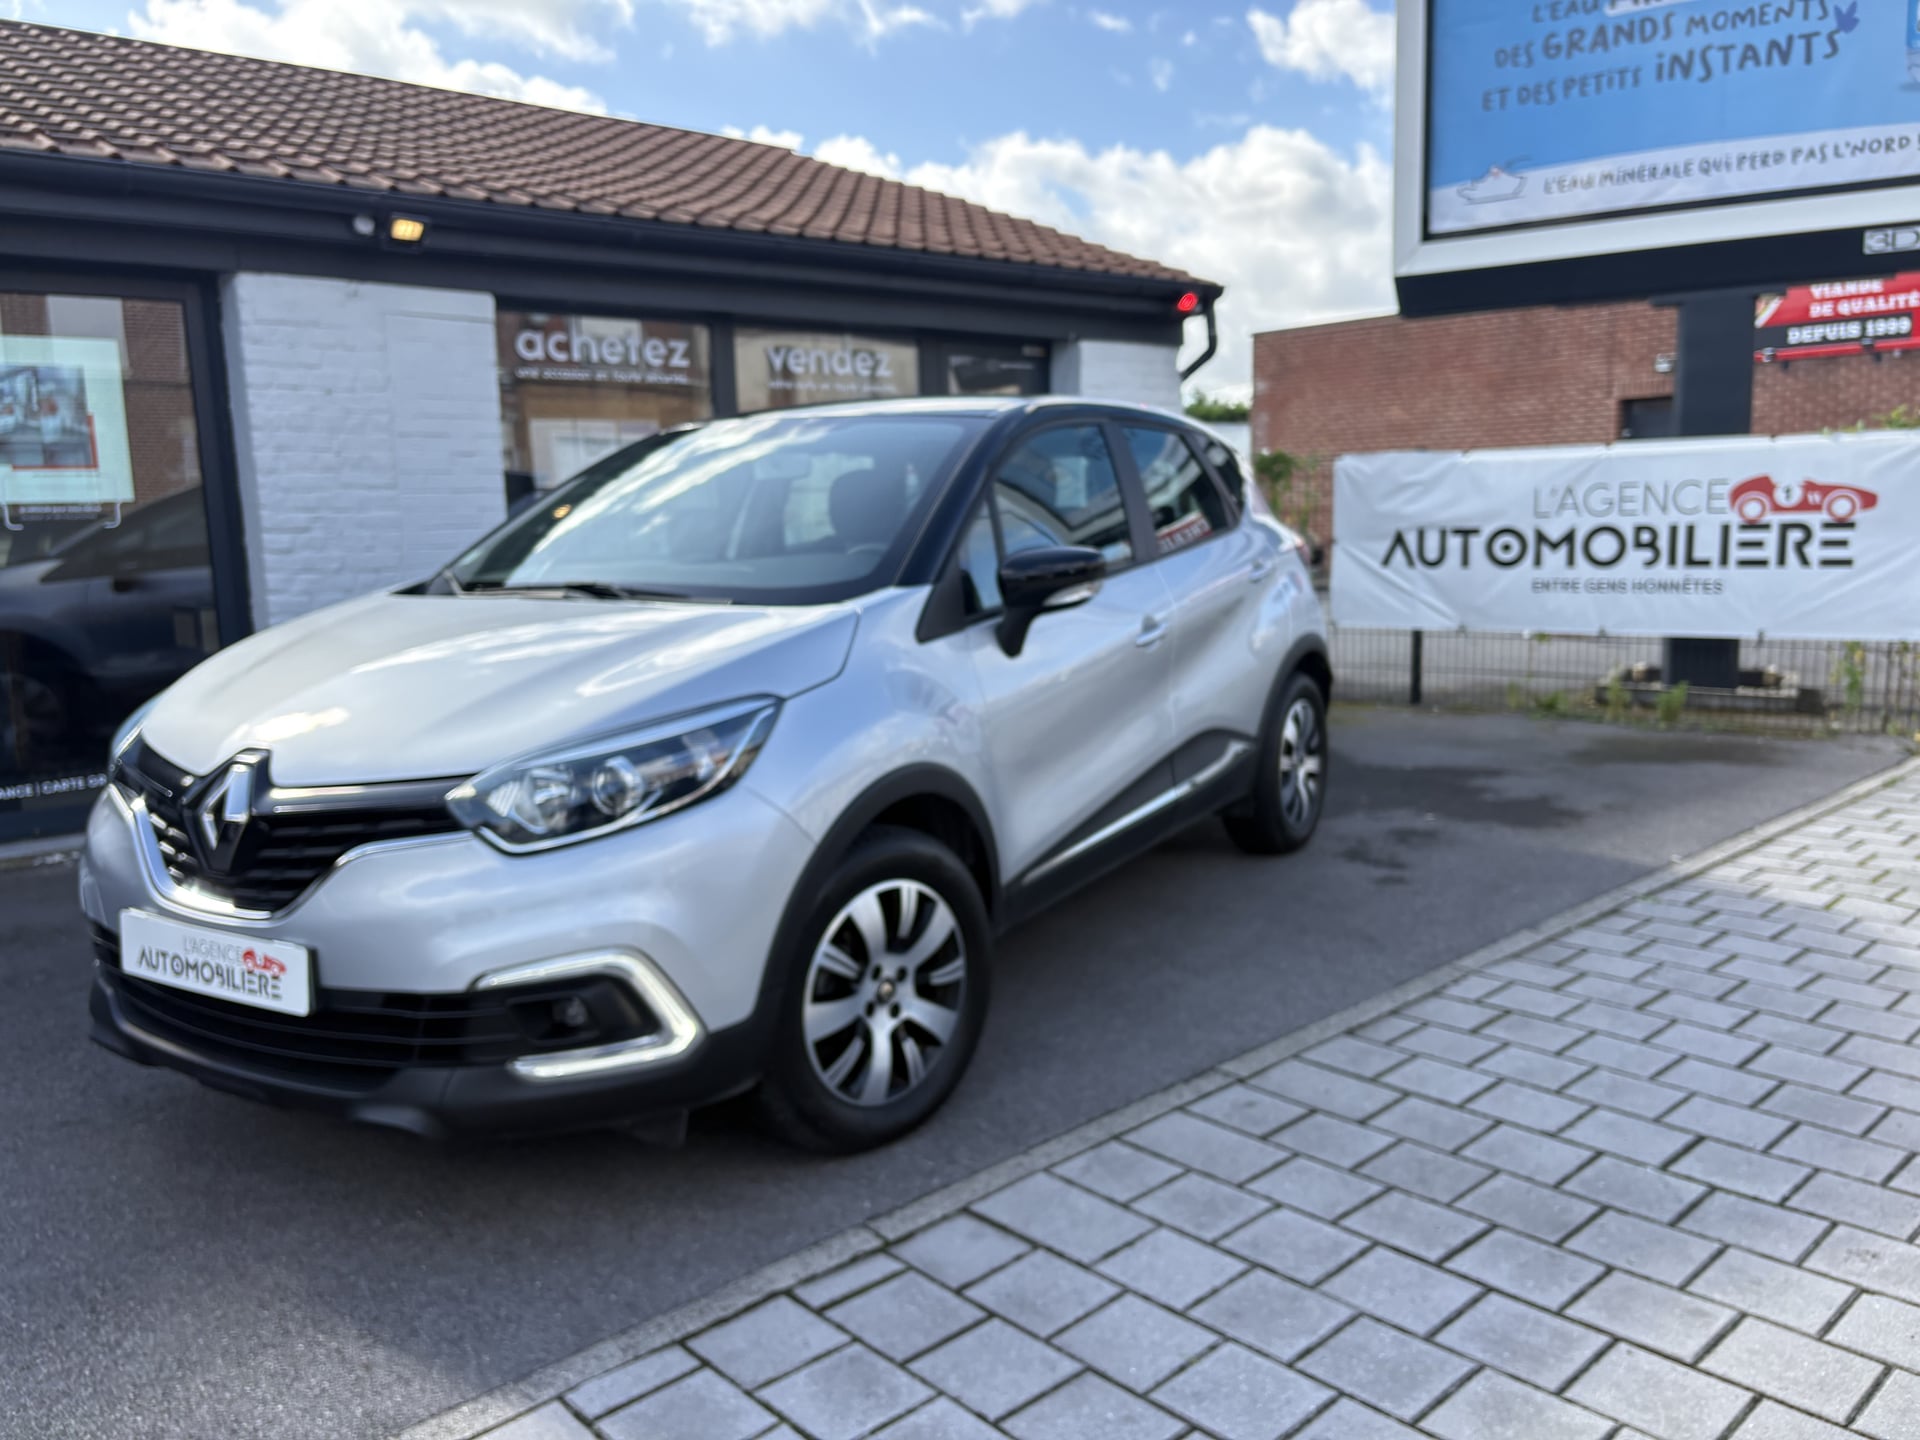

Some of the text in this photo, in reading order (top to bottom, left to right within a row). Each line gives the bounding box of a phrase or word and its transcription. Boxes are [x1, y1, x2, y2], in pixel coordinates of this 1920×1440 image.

[1494, 0, 1829, 68] DES GRANDS MOMENTS
[1481, 86, 1510, 112] ET
[1516, 79, 1557, 105] DES
[1736, 150, 1786, 172] PERD
[1791, 142, 1829, 164] PAS
[1833, 135, 1912, 158] L'NORD
[1810, 279, 1883, 300] VIANDE
[1808, 301, 1834, 319] DE
[1787, 316, 1912, 344] DEPUIS 1999
[515, 324, 690, 367] achetez
[767, 343, 893, 378] vendez
[1532, 478, 1731, 519] L'AGENCE
[1531, 573, 1724, 595] ENTRE GENS HONNÊTES
[41, 777, 85, 795] CARTE
[183, 935, 243, 963] L'AGENCE
